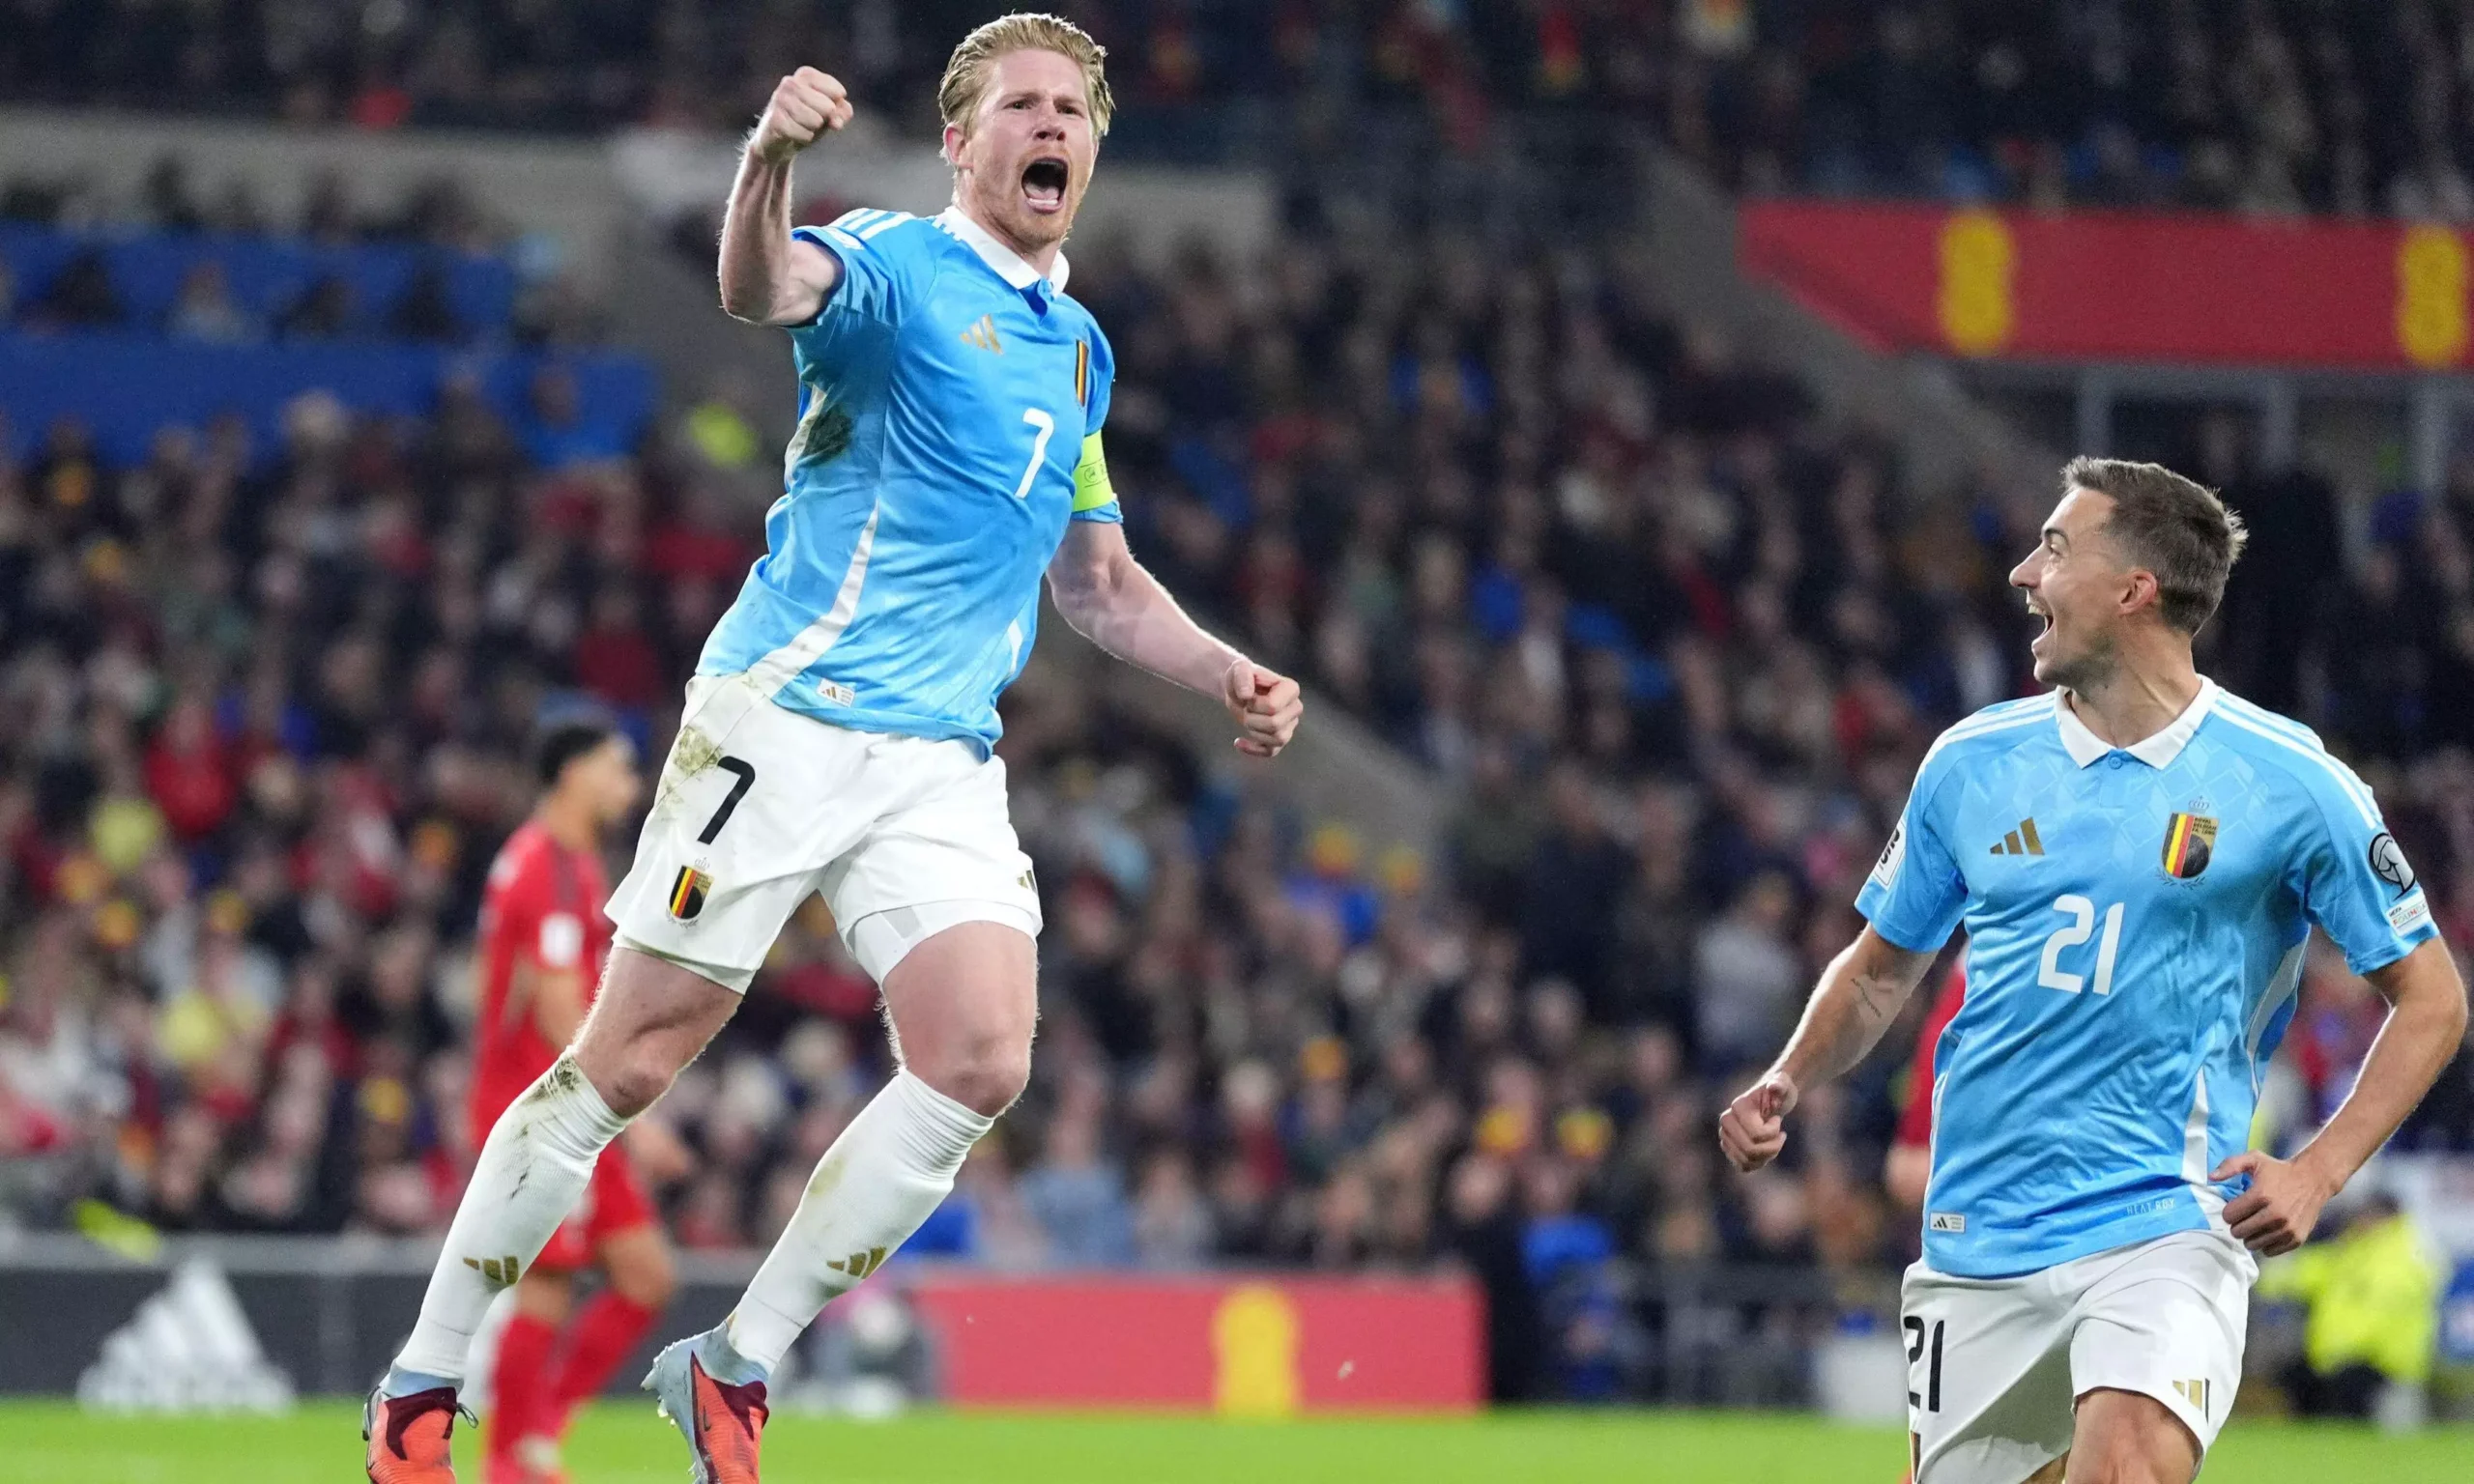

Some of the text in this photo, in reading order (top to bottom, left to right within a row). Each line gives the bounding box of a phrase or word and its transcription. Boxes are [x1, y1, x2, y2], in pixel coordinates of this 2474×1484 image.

[1014, 407, 1054, 499] 7
[697, 756, 756, 845] 7
[2037, 893, 2125, 996] 21
